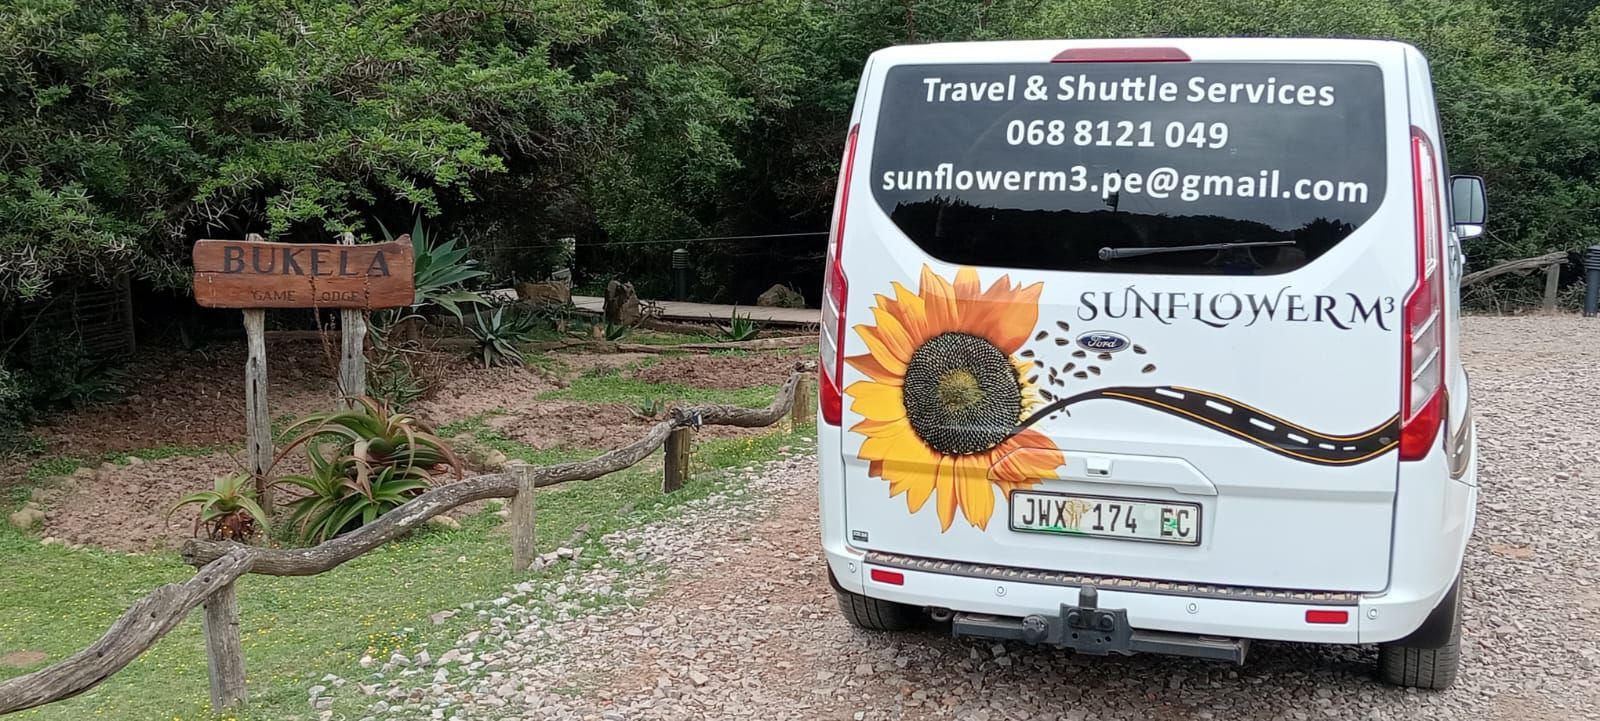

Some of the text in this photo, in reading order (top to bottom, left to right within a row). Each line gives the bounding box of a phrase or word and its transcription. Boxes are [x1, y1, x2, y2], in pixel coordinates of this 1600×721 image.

[923, 75, 1336, 107] Travel & Shuttle Services
[1006, 120, 1230, 150] 068 8121 049
[881, 163, 1369, 205] sunflowerm3.pe@gmail.com
[222, 245, 391, 278] BUKELA
[251, 289, 297, 302] GAME
[1087, 333, 1119, 350] Ford
[1022, 497, 1191, 538] JWX 174 EC
